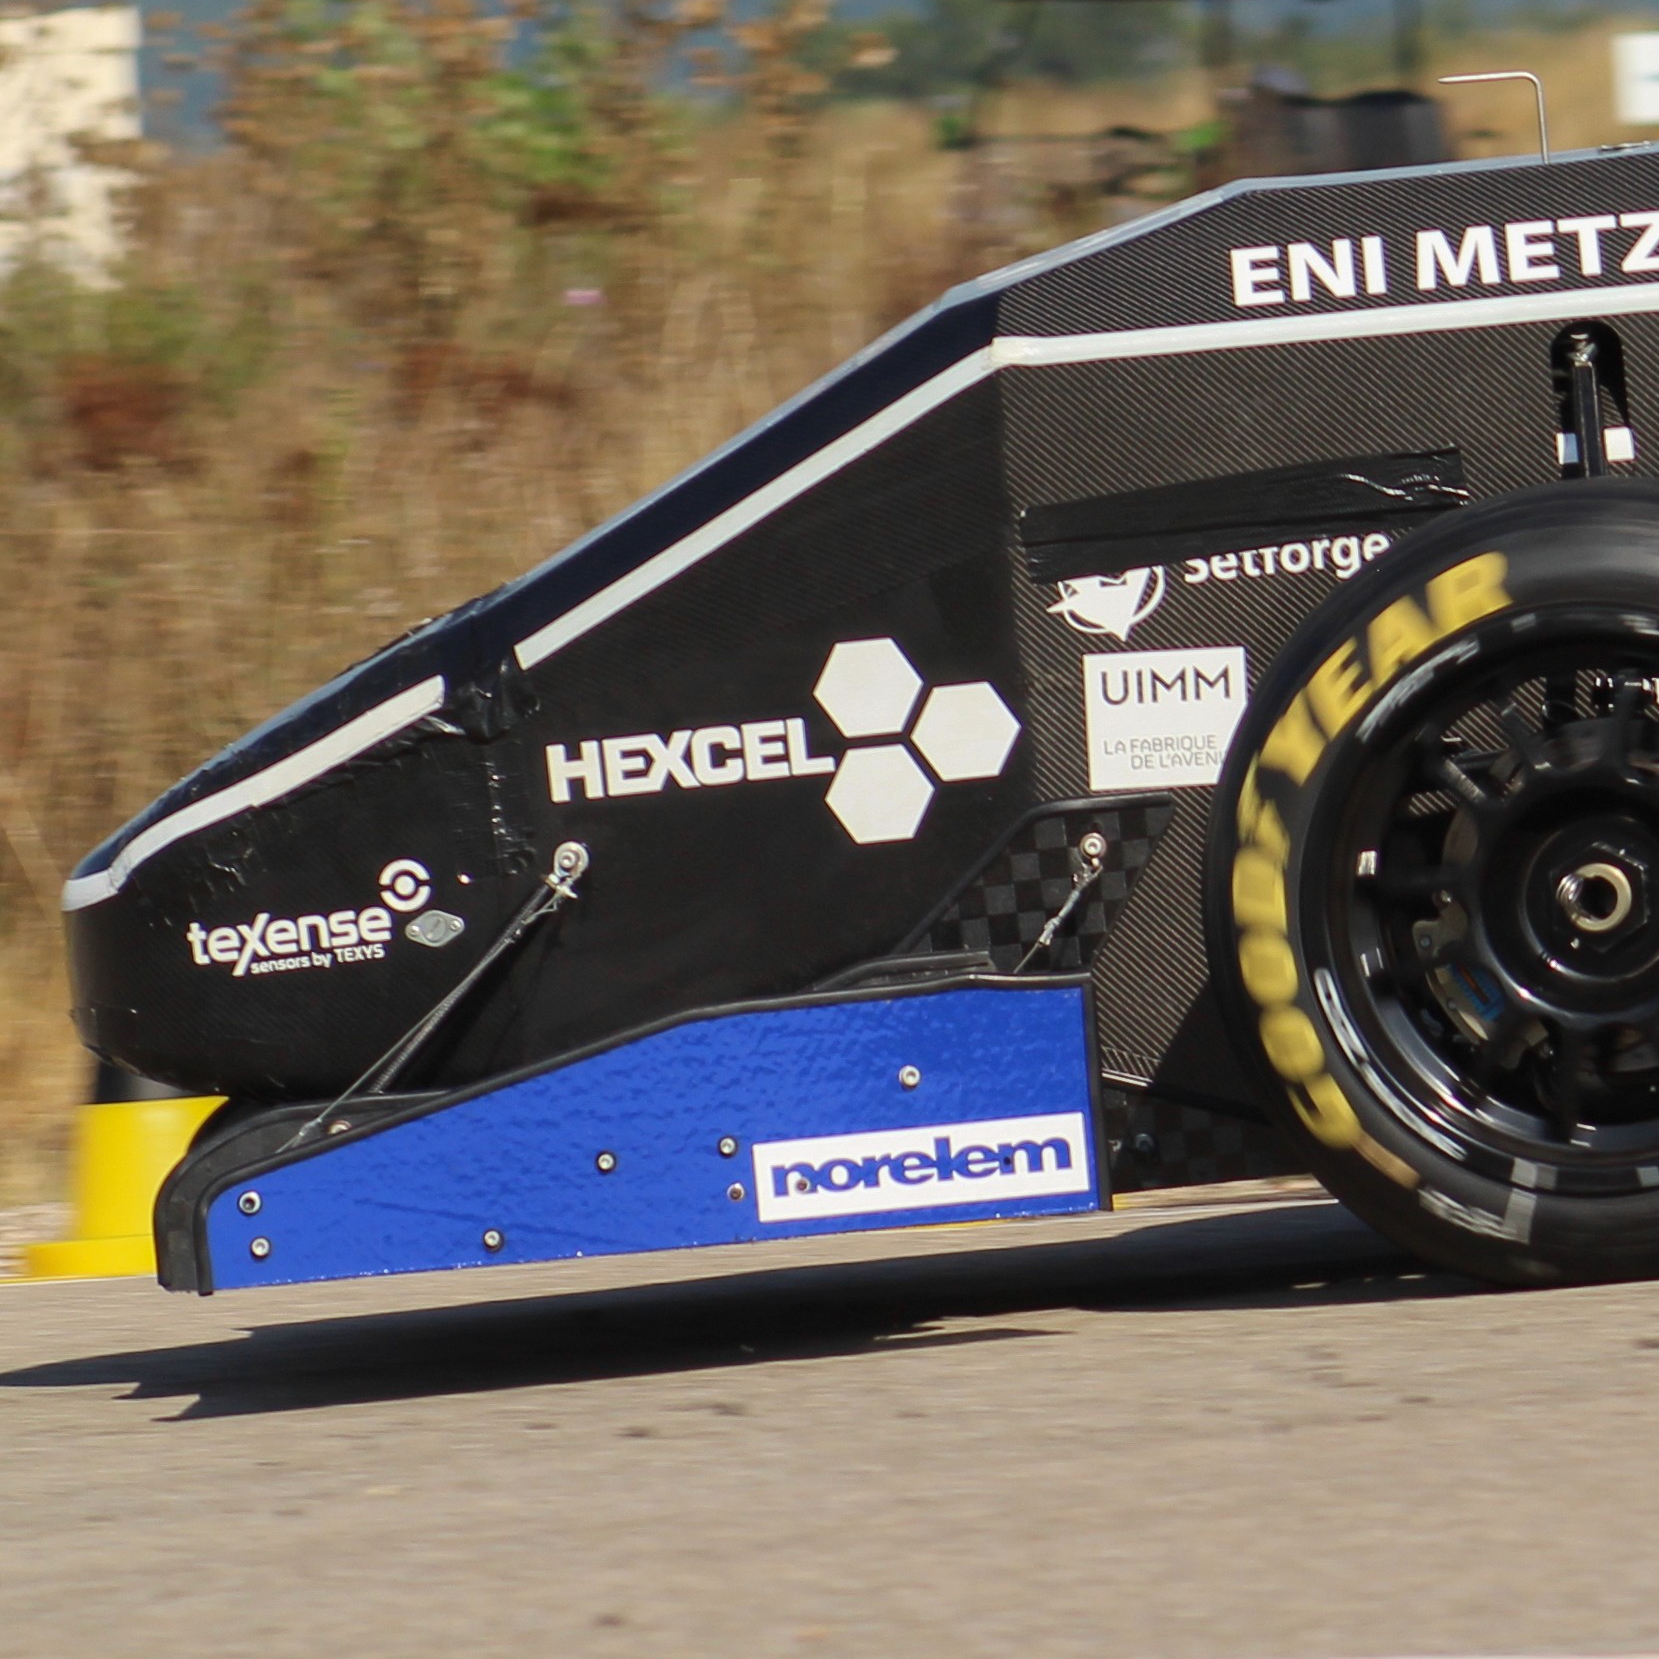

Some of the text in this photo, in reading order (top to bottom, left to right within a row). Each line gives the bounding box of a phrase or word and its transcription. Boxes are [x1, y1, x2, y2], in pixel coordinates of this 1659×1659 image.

[1229, 235, 1387, 308] ENI
[1100, 664, 1231, 706] UIMM
[545, 717, 836, 803] HEXCEL
[1103, 733, 1217, 755] LA FABRIQUE
[1130, 753, 1155, 771] DE
[250, 943, 386, 975] sensors by TEXYS
[770, 1136, 1072, 1198] norelem
